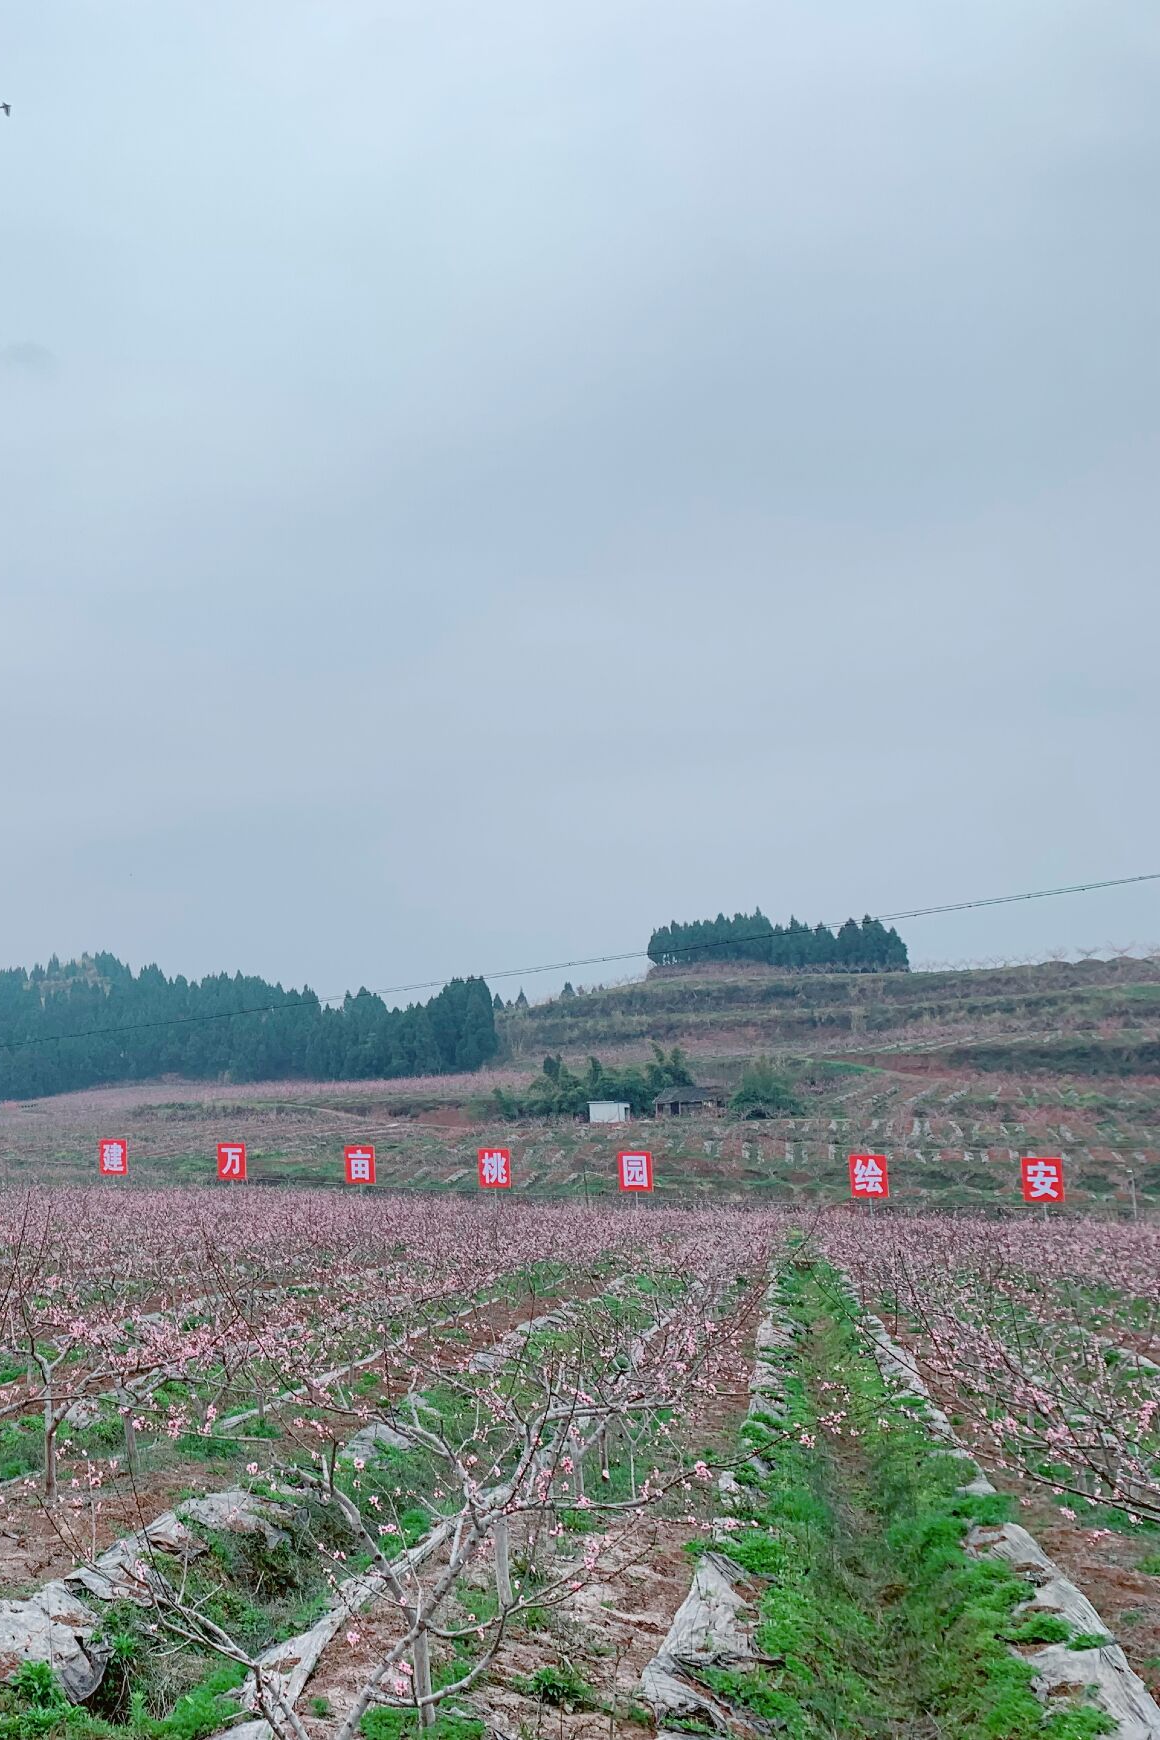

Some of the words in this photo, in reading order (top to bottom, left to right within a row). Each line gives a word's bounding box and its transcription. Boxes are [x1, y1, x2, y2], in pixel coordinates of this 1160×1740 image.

[102, 1143, 124, 1172] 建
[221, 1147, 243, 1173] 万
[348, 1149, 371, 1180] 亩
[483, 1154, 507, 1184] 桃
[623, 1155, 648, 1187] 园
[854, 1160, 883, 1193] 绘
[1026, 1162, 1058, 1198] 安
